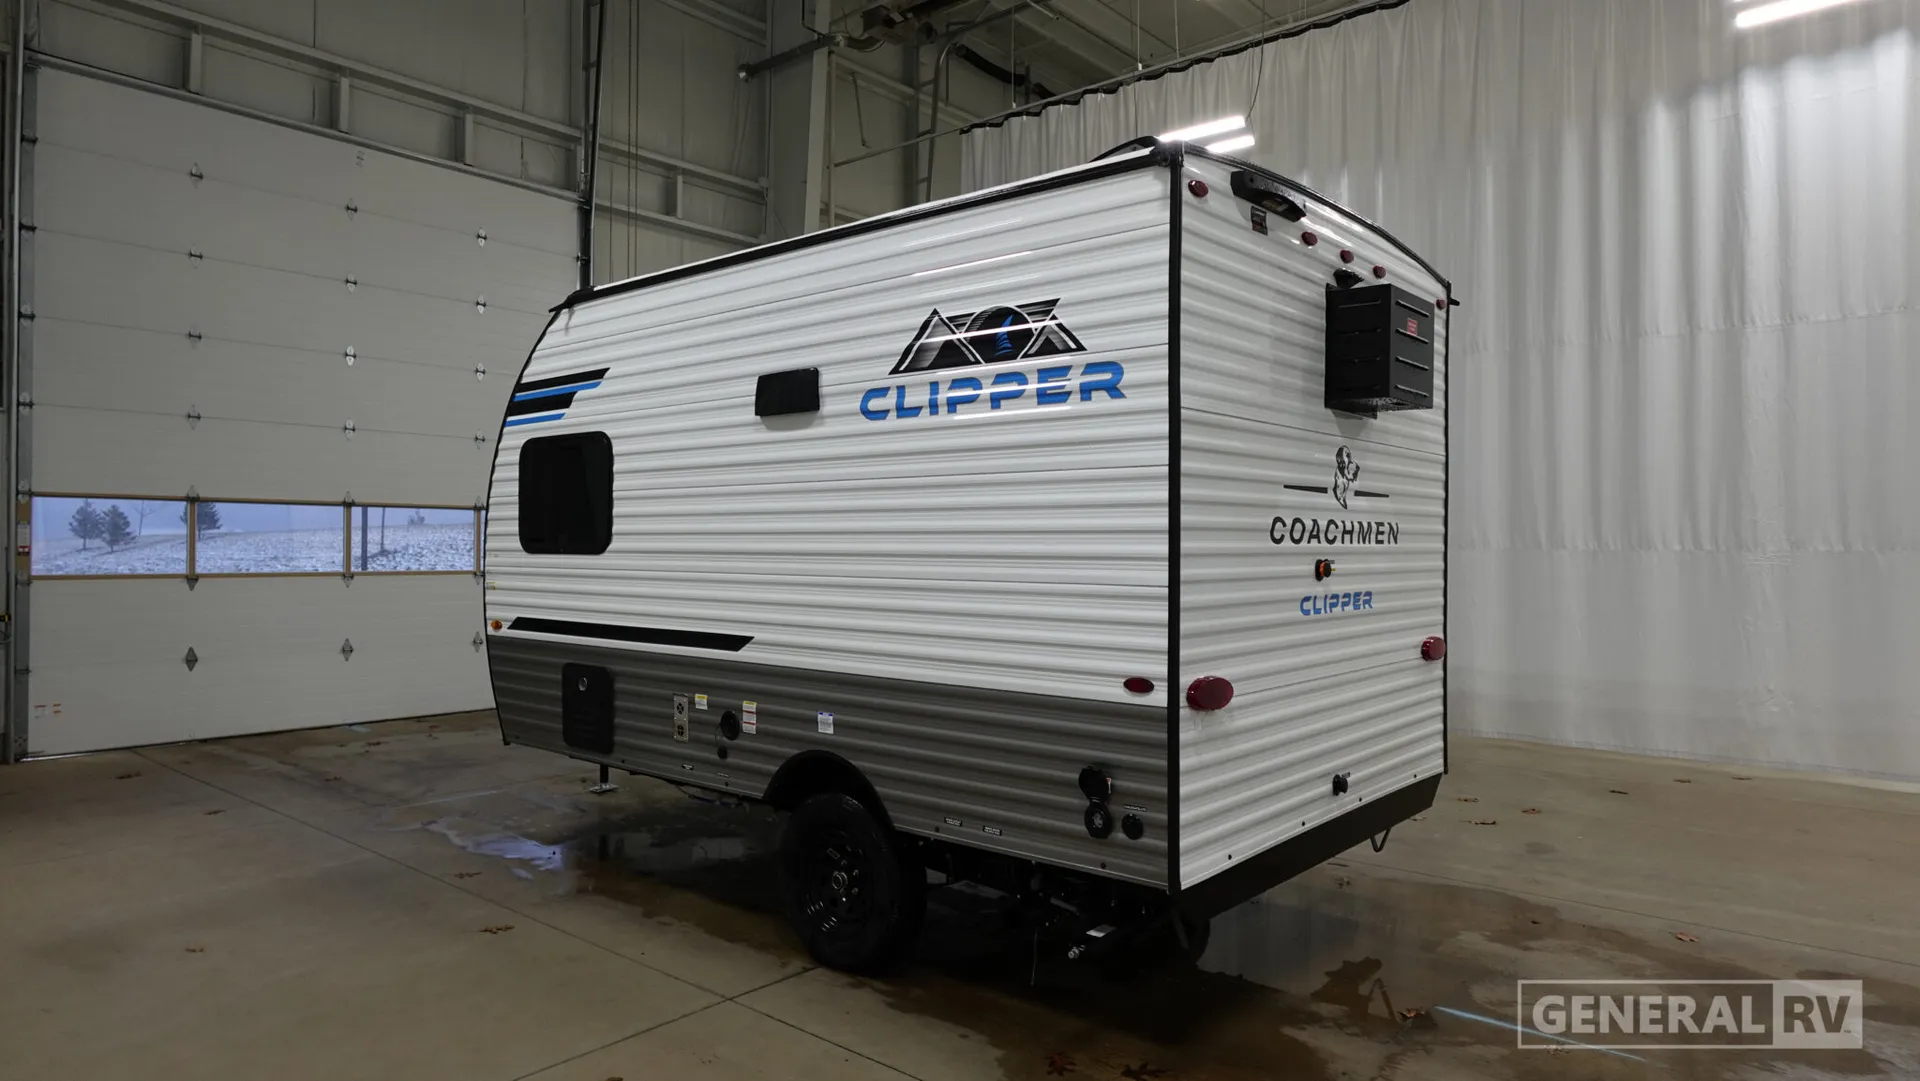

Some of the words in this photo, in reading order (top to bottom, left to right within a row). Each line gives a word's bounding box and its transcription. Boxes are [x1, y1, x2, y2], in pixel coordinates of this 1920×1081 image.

[859, 361, 1127, 421] CLIPPER
[1269, 516, 1399, 545] COACHMEN
[1299, 590, 1374, 616] CLIPPER
